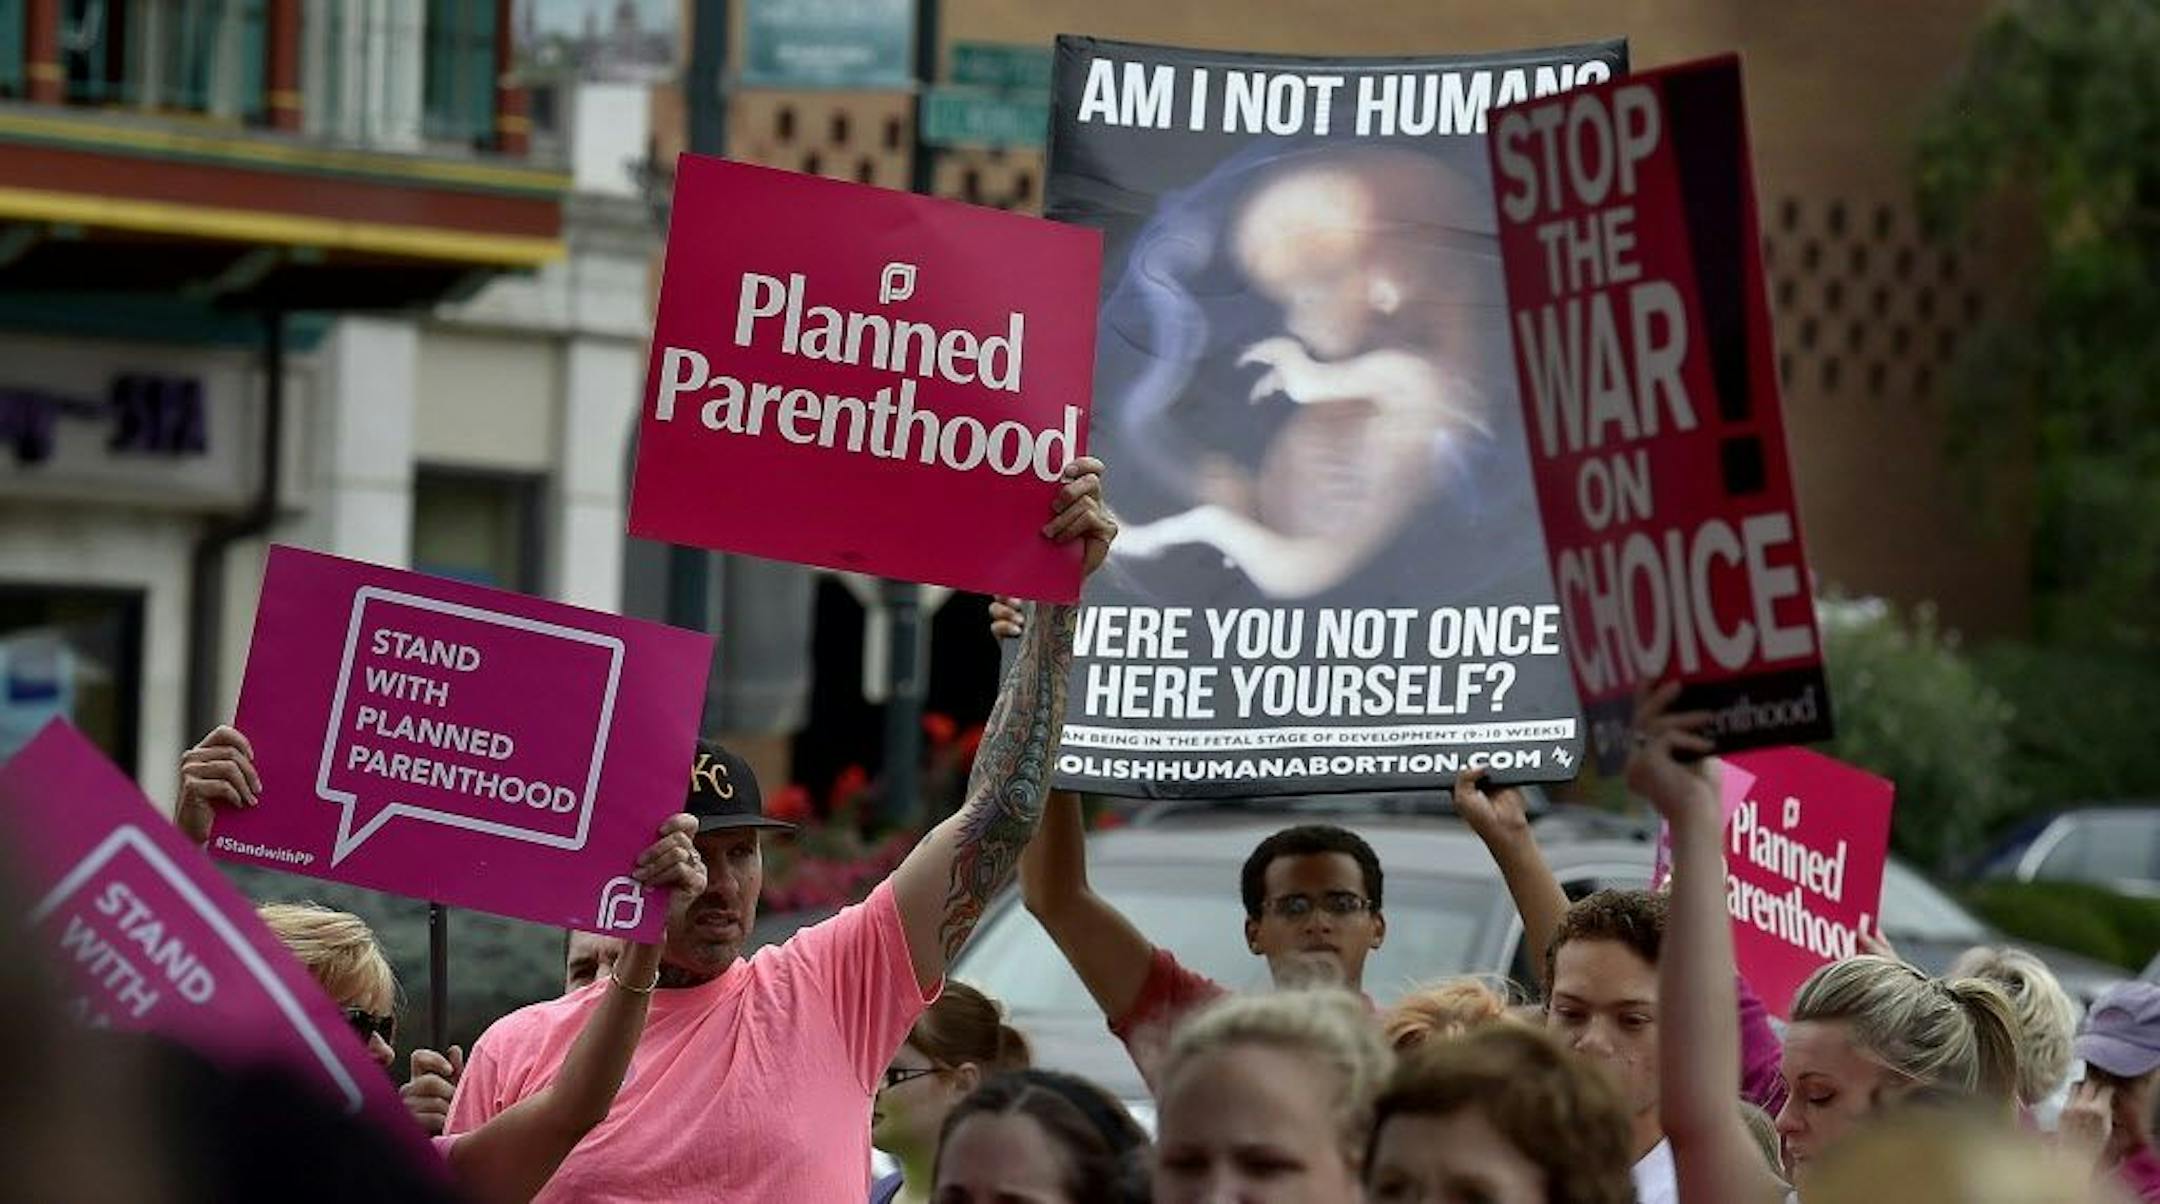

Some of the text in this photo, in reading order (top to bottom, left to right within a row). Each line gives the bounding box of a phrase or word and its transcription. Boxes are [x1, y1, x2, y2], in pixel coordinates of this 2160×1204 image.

[1077, 58, 1175, 129] AM
[1189, 69, 1207, 131] I
[1222, 71, 1344, 135] NOT
[1498, 84, 1662, 225] STOP
[1537, 206, 1642, 298] THE
[733, 272, 1025, 393] Planned
[1518, 279, 1698, 458] WAR
[655, 346, 1079, 483] Parenthood
[1577, 451, 1654, 532] ON
[1205, 608, 1304, 660] YOU
[1315, 607, 1419, 660] NOT
[1428, 604, 1561, 659] ONCE
[1558, 511, 1815, 695] CHOICE
[365, 666, 450, 707] WITH
[371, 628, 482, 672] STAND
[1085, 661, 1516, 719] HERE YOURSELF?
[355, 705, 515, 761] PLANNED
[1054, 749, 1542, 781] OLISHHUMANABORTION.COM
[1062, 731, 1085, 744] AN
[1090, 732, 1138, 746] BEING
[1145, 736, 1161, 747] IN
[1167, 736, 1199, 747] THE
[1204, 735, 1252, 747] FETAL
[1257, 732, 1308, 745] STAGE
[1313, 731, 1334, 743] OF
[1339, 730, 1458, 744] DEVELOPMENT
[1506, 726, 1567, 739] WEEKS)
[347, 744, 577, 814] PARENTHOOD
[691, 754, 734, 800] KC
[215, 836, 315, 866] #StandwithPP
[1731, 801, 1848, 903] Planned
[94, 881, 217, 1005] STAND
[1722, 858, 1871, 961] arenthoo
[59, 913, 161, 1018] WITH
